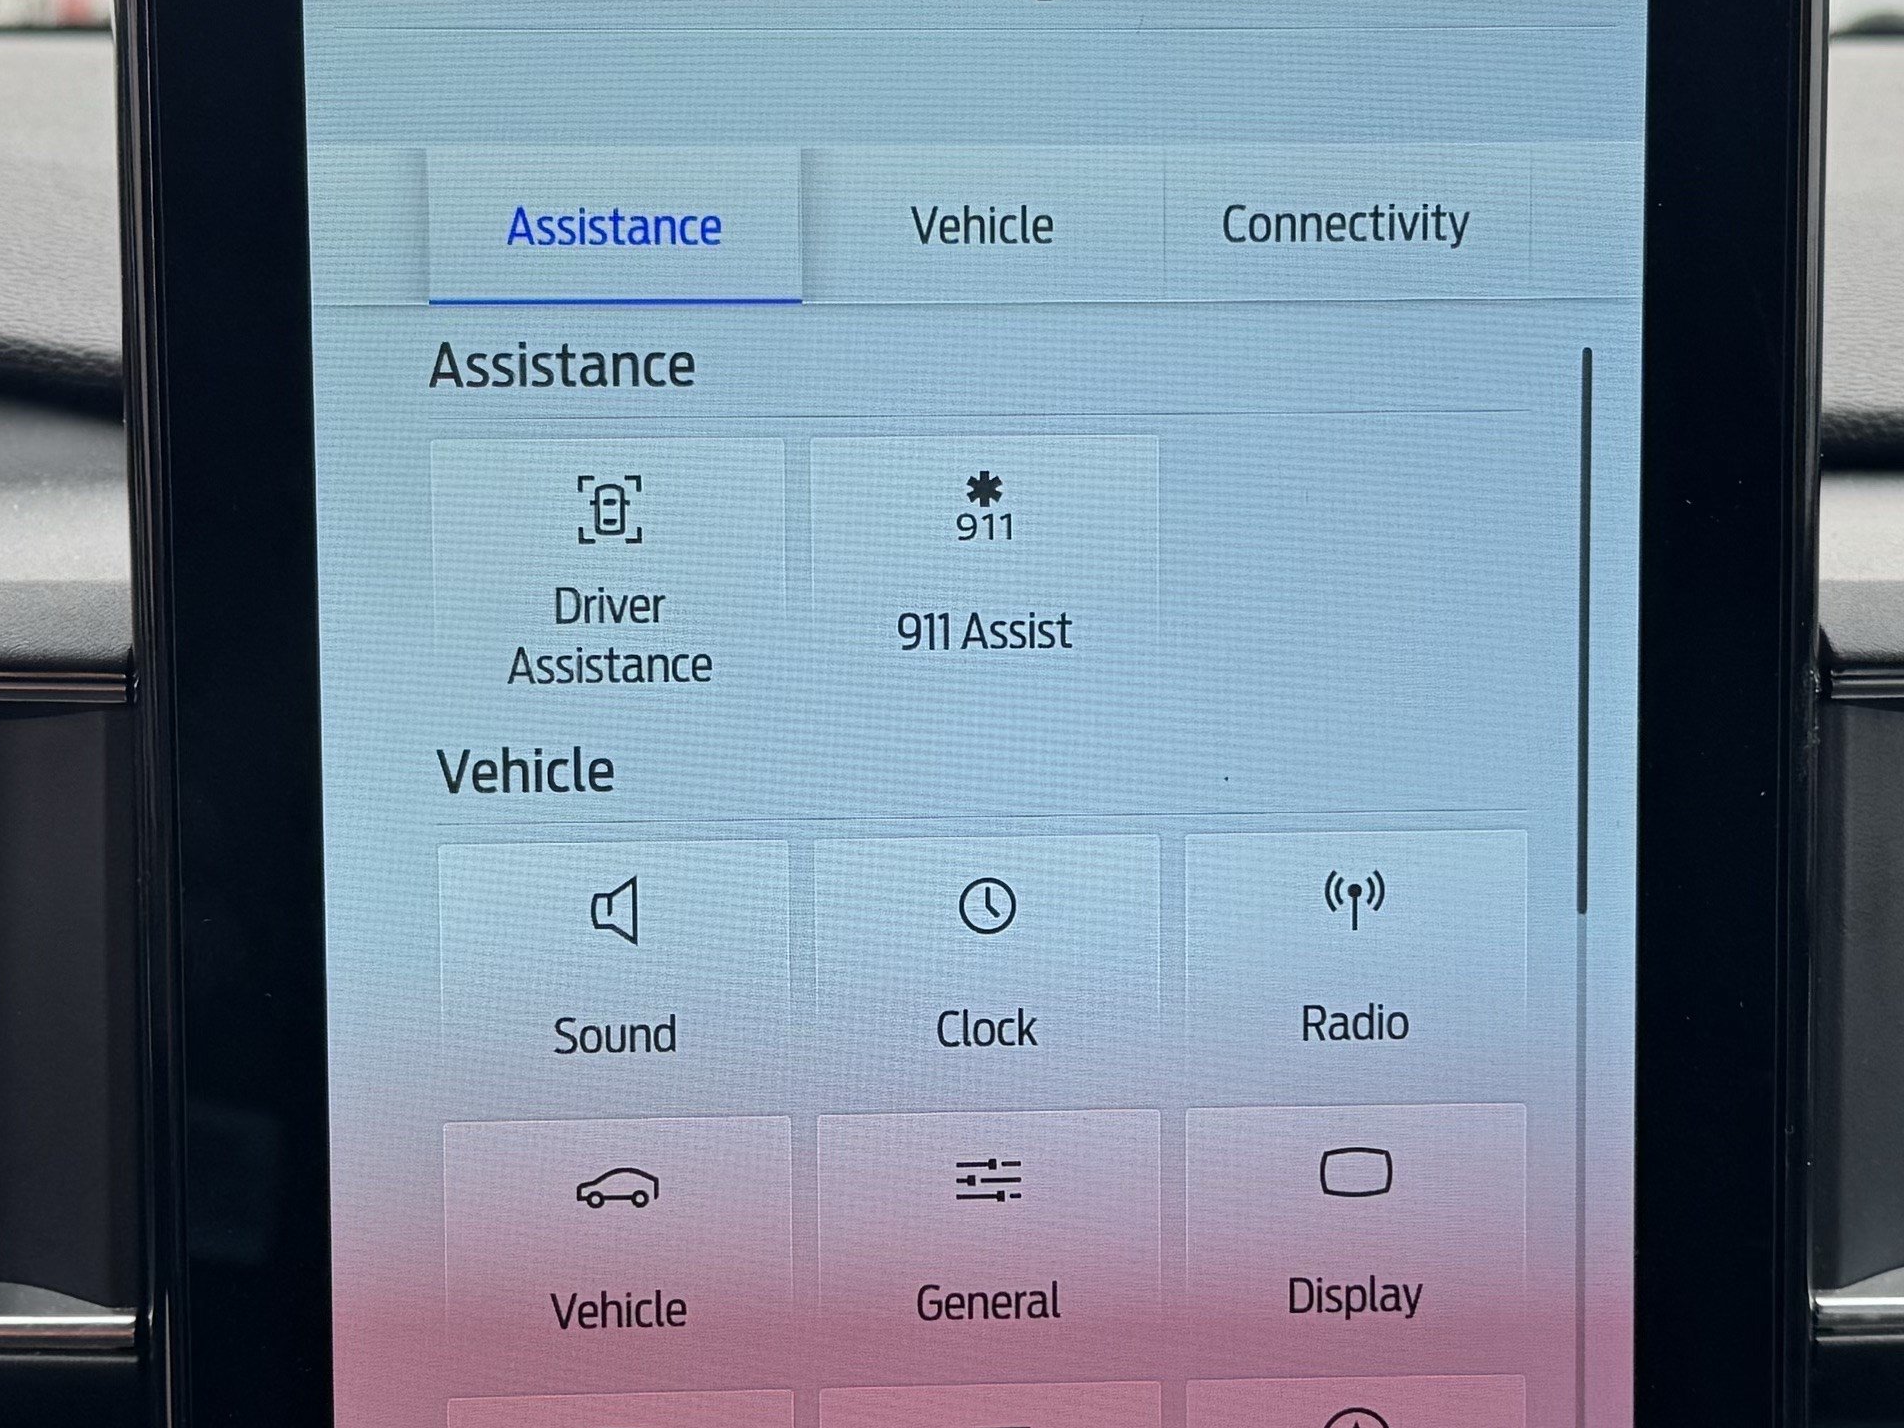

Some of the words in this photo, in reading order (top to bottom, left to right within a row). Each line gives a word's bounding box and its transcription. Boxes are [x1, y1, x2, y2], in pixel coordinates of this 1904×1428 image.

[507, 206, 722, 246] Assistance
[910, 204, 1054, 245] Vehicle
[1223, 203, 1470, 249] Connectivity
[429, 341, 695, 388] Assistance
[956, 512, 1012, 541] 911
[555, 586, 666, 625] Driver
[897, 612, 950, 651] 911
[961, 611, 1073, 650] Assist
[507, 646, 713, 685] Assistance
[436, 745, 614, 794] Vehicle
[554, 1013, 676, 1055] Sound
[937, 1007, 1038, 1048] Clock
[1303, 1002, 1409, 1042] Radio
[550, 1289, 687, 1330] Vehicle
[917, 1280, 1061, 1322] General
[1289, 1274, 1423, 1321] Display
